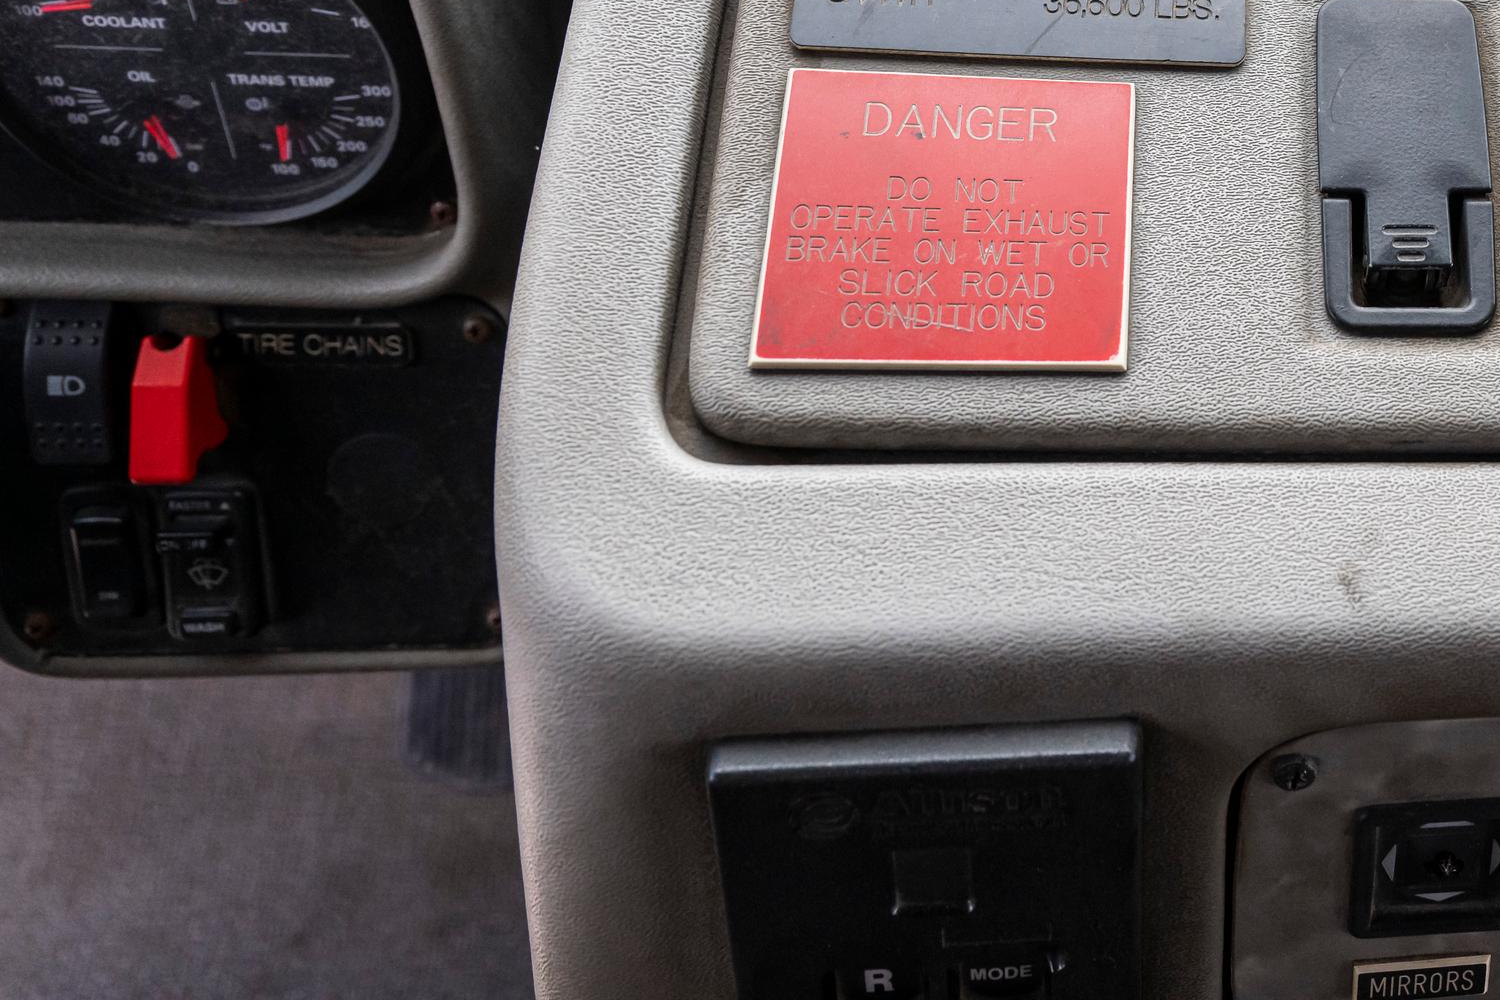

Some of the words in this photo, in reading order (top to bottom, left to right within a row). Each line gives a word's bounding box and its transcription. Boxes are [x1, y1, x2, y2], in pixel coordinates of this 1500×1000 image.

[14, 5, 43, 16] 100
[82, 14, 165, 29] COOLANT
[244, 21, 289, 34] VOLT
[35, 75, 65, 87] 140
[127, 70, 157, 83] OIL
[226, 73, 286, 86] TRANS
[288, 75, 335, 87] TEMP
[360, 85, 392, 97] 300
[47, 95, 76, 107] 100
[356, 116, 386, 128] 250
[862, 101, 1058, 142] DANGER
[336, 140, 368, 152] 200
[136, 151, 159, 163] 20
[887, 176, 932, 201] DO
[955, 177, 1025, 203] NOT
[790, 204, 943, 233] OPERATE
[963, 208, 1111, 237] EXHAUST
[785, 235, 892, 264] BRAKE
[913, 238, 957, 265] ON
[978, 240, 1050, 266] WET
[1069, 242, 1111, 268] OR
[837, 269, 937, 297] SLICK
[961, 272, 1055, 299] ROAD
[841, 302, 1048, 331] CONDITIONS
[238, 333, 296, 356] TIRE
[303, 333, 405, 357] CHAINS
[864, 968, 896, 993] R
[969, 964, 1033, 982] MODE
[1369, 969, 1475, 1000] MIRRORS
